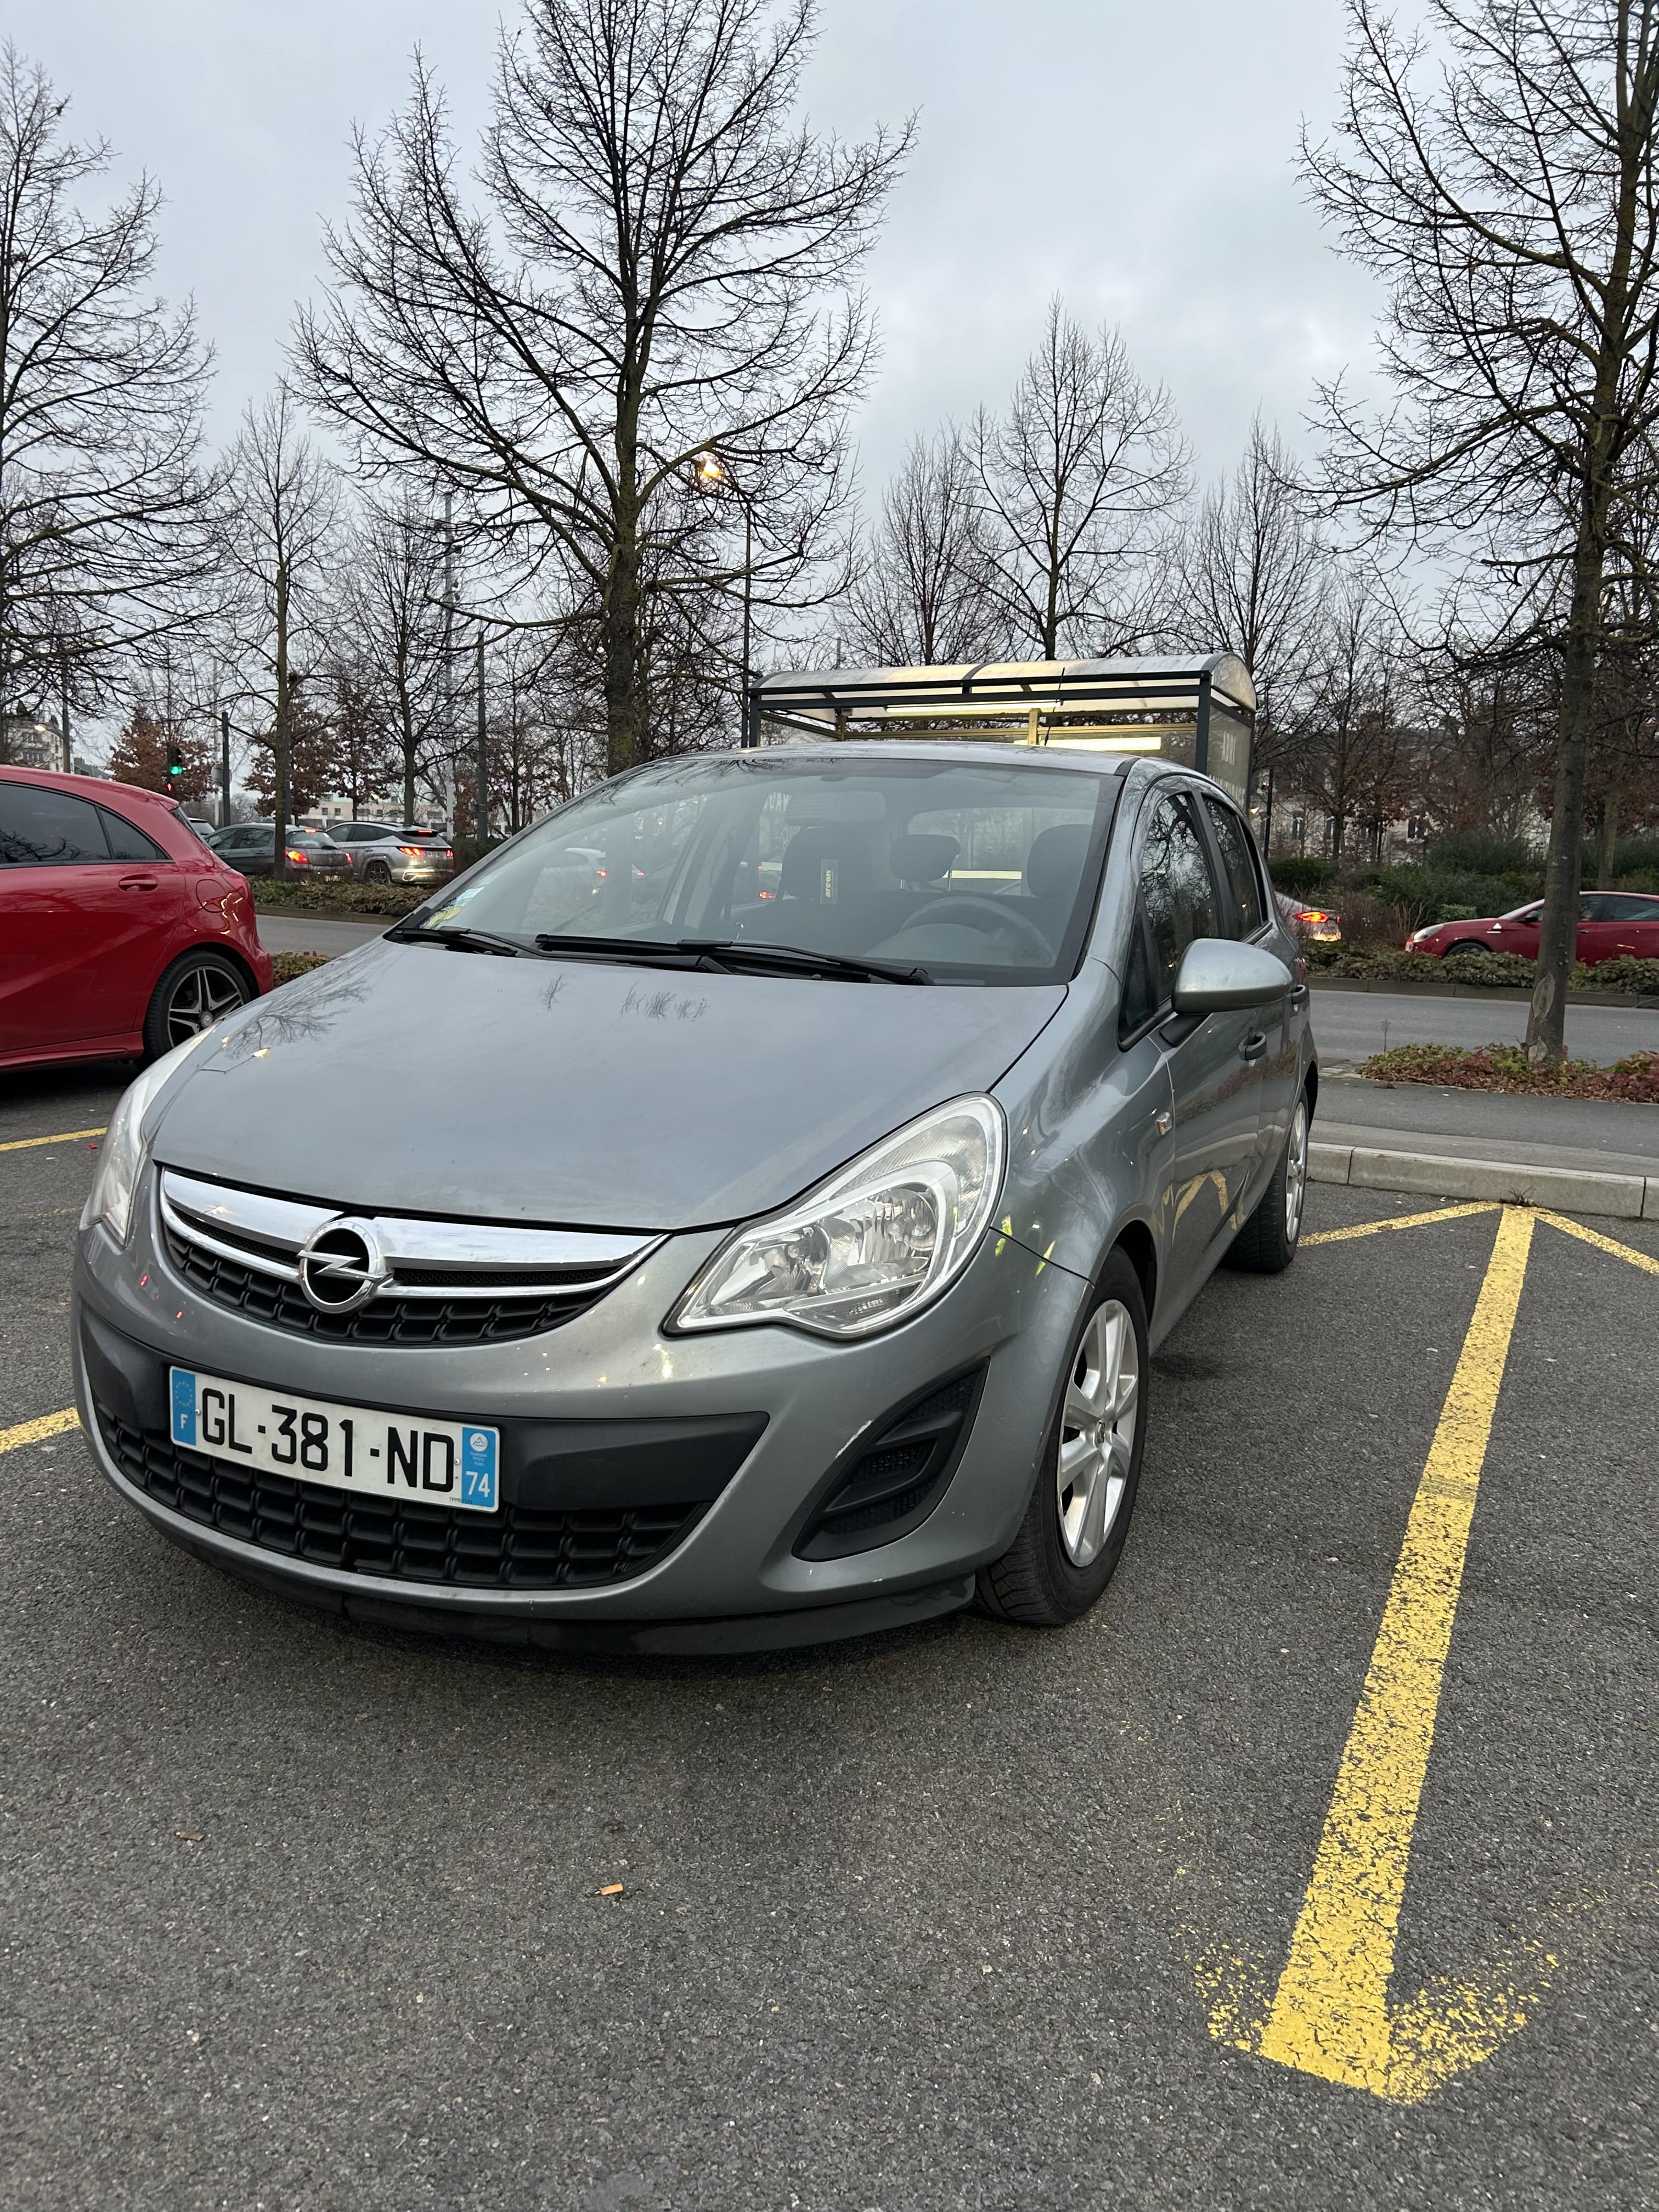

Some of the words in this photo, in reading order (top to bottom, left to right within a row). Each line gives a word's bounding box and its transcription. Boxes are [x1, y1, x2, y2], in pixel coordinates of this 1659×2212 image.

[323, 1222, 366, 1238] PEL
[180, 1413, 188, 1429] F
[202, 1387, 454, 1493] GL-381-ND
[466, 1471, 490, 1497] 74
